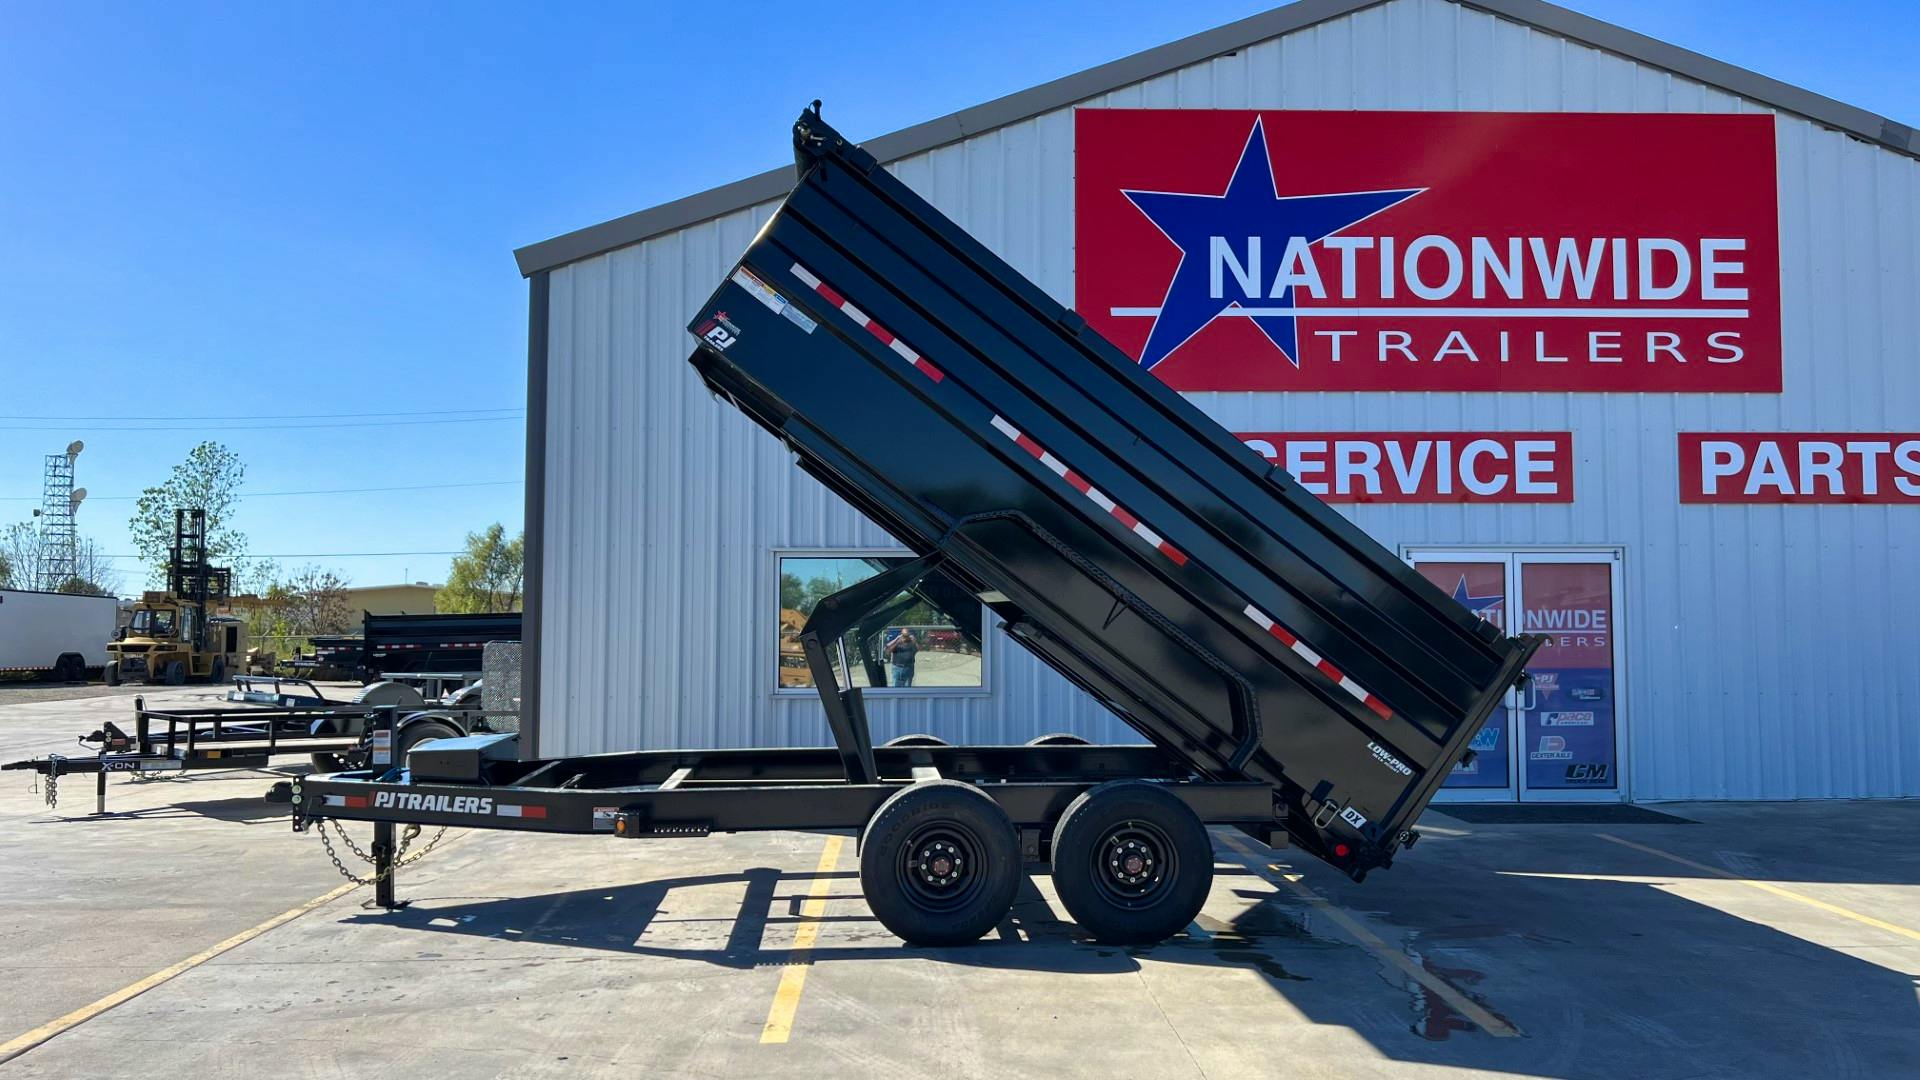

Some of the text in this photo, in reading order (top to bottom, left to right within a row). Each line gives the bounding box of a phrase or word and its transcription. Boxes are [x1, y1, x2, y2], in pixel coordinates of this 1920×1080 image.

[1209, 235, 1749, 301] NATIONWIDE
[706, 326, 737, 348] PJ
[1314, 331, 1746, 364] TRAILERS
[1471, 608, 1607, 629] TINWIDE
[1366, 741, 1412, 776] LOW-PRO
[374, 791, 493, 815] PJ TRAILERS
[1344, 810, 1362, 825] DX
